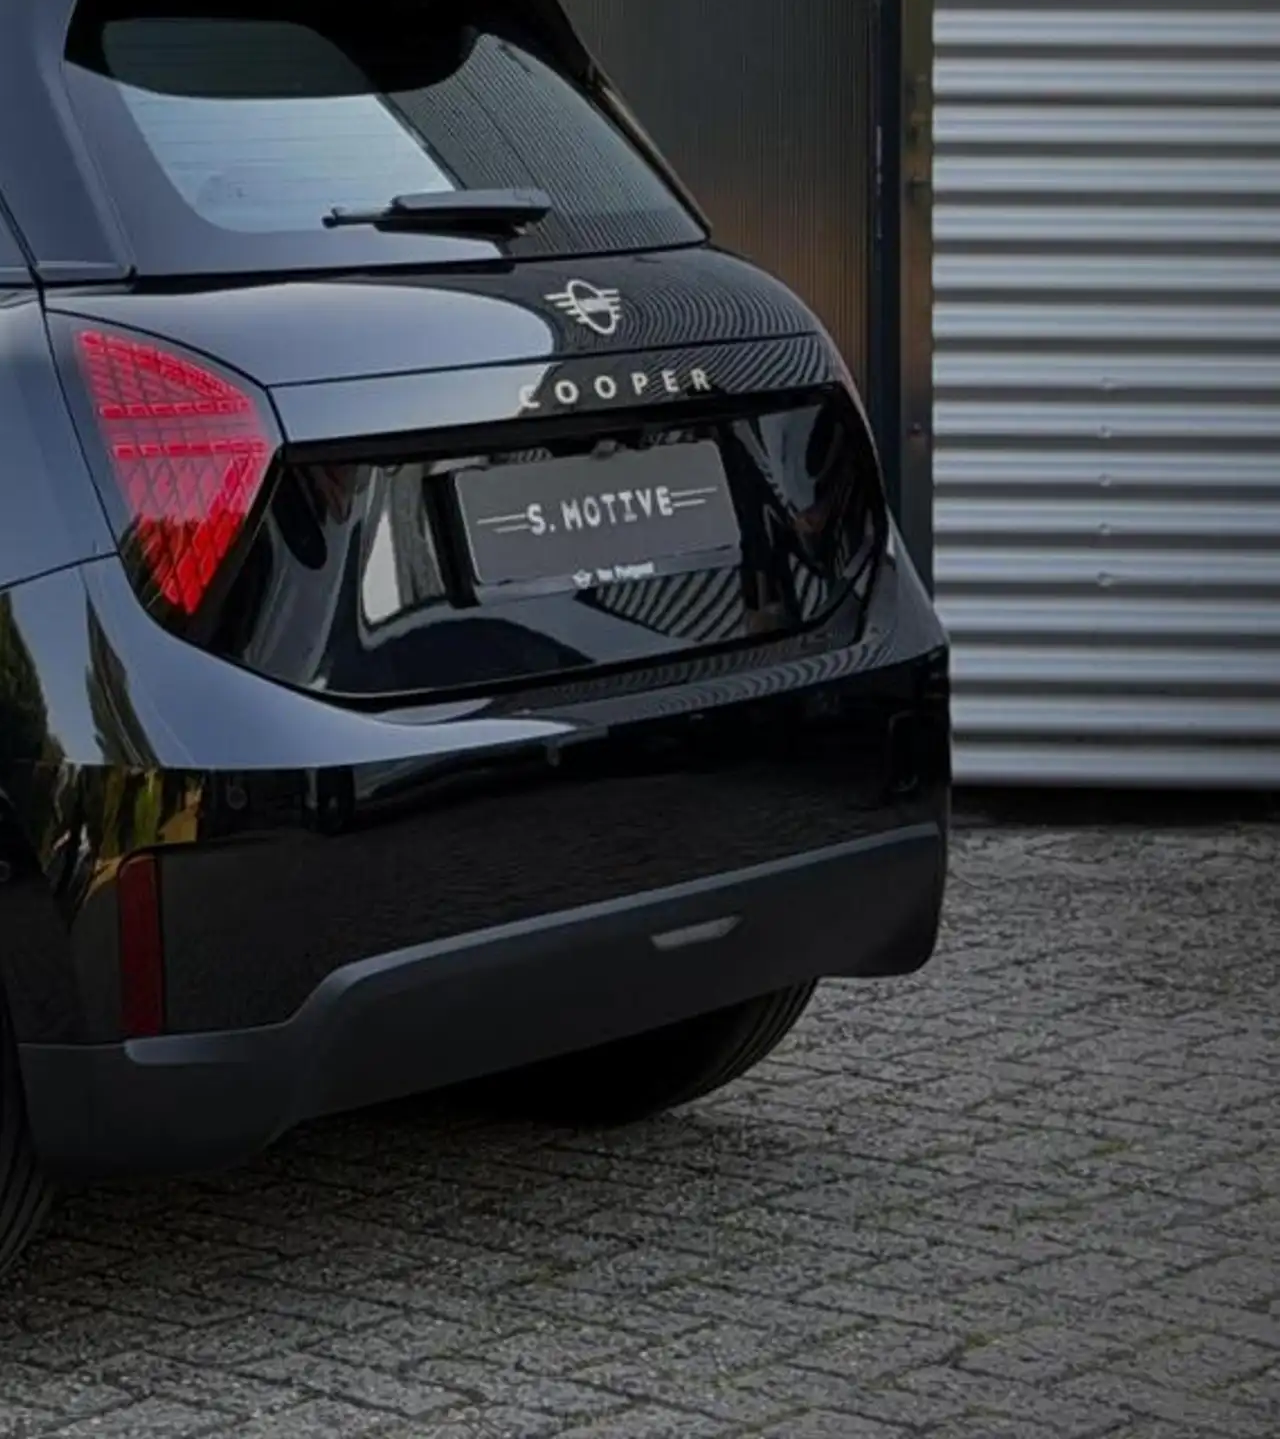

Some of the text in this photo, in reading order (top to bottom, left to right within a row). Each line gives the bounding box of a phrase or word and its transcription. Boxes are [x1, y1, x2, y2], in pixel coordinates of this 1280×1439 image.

[518, 368, 712, 409] COOPER
[526, 485, 674, 536] S. MOTIVE
